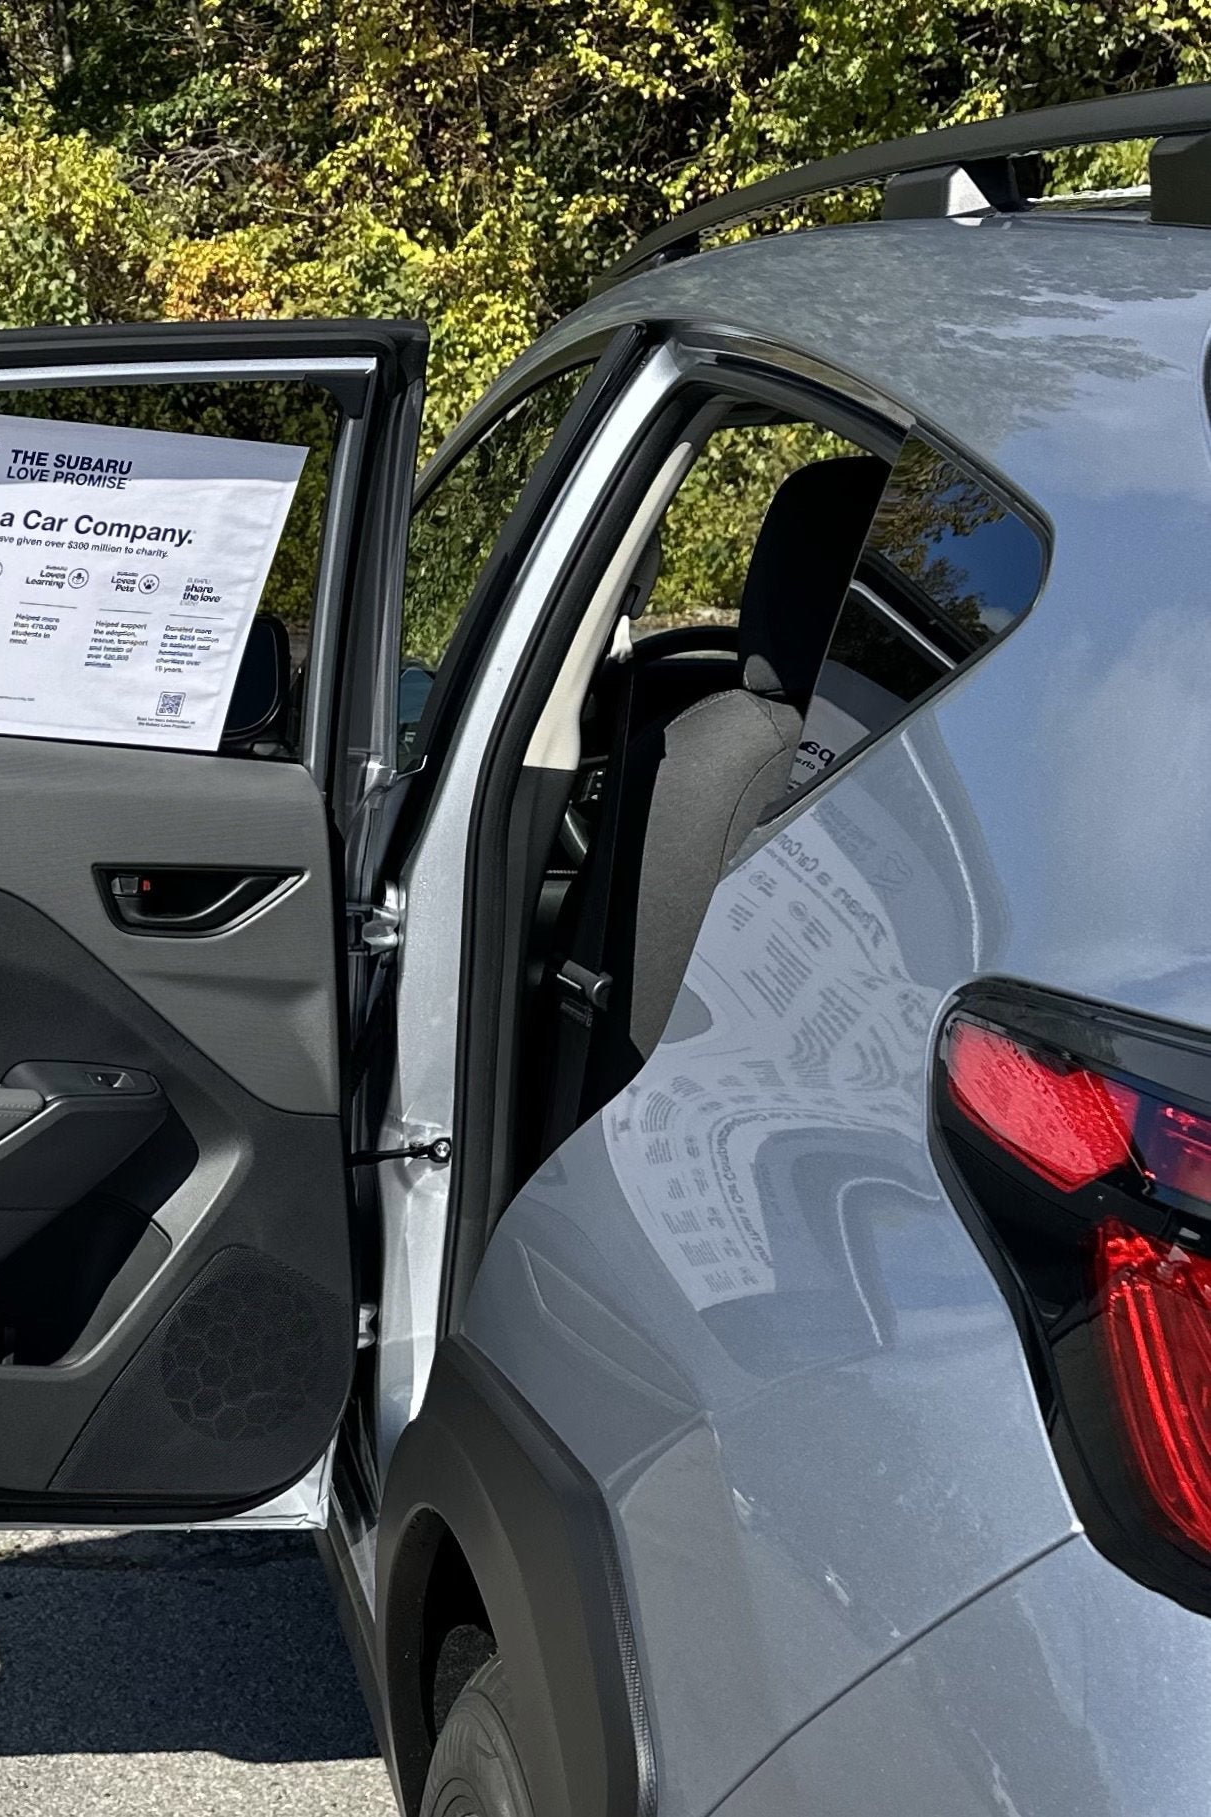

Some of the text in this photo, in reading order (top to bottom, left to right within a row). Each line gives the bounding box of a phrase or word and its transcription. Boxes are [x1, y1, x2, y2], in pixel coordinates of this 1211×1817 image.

[11, 450, 132, 475] THE SUBARU
[6, 467, 128, 489] LOVE PROMISE
[0, 511, 14, 527] a
[23, 509, 68, 532] Car
[75, 514, 193, 544] Company.
[17, 536, 42, 547] given
[45, 540, 65, 549] over
[68, 540, 89, 550] $300
[91, 543, 122, 553] million
[124, 546, 134, 554] to
[40, 570, 66, 580] Loves
[111, 575, 136, 585] Loves
[25, 577, 65, 589] Learning
[115, 584, 136, 592] Pets
[184, 584, 214, 594] share
[182, 592, 221, 603] the love
